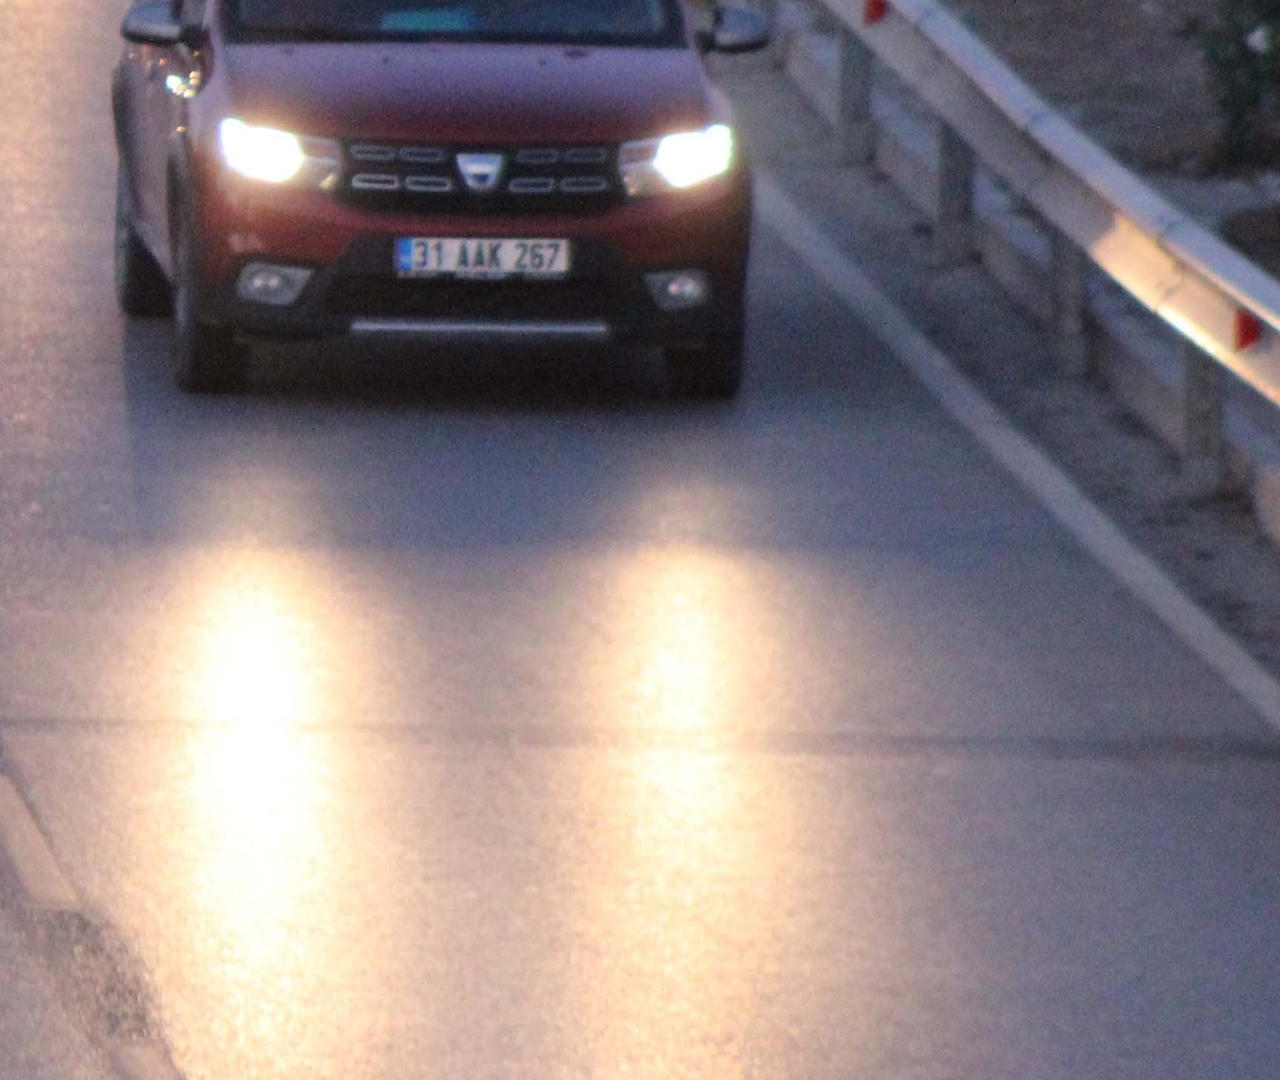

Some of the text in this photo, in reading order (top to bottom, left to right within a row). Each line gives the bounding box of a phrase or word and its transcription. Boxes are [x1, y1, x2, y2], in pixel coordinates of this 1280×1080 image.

[414, 241, 560, 270] 31 AAK 267
